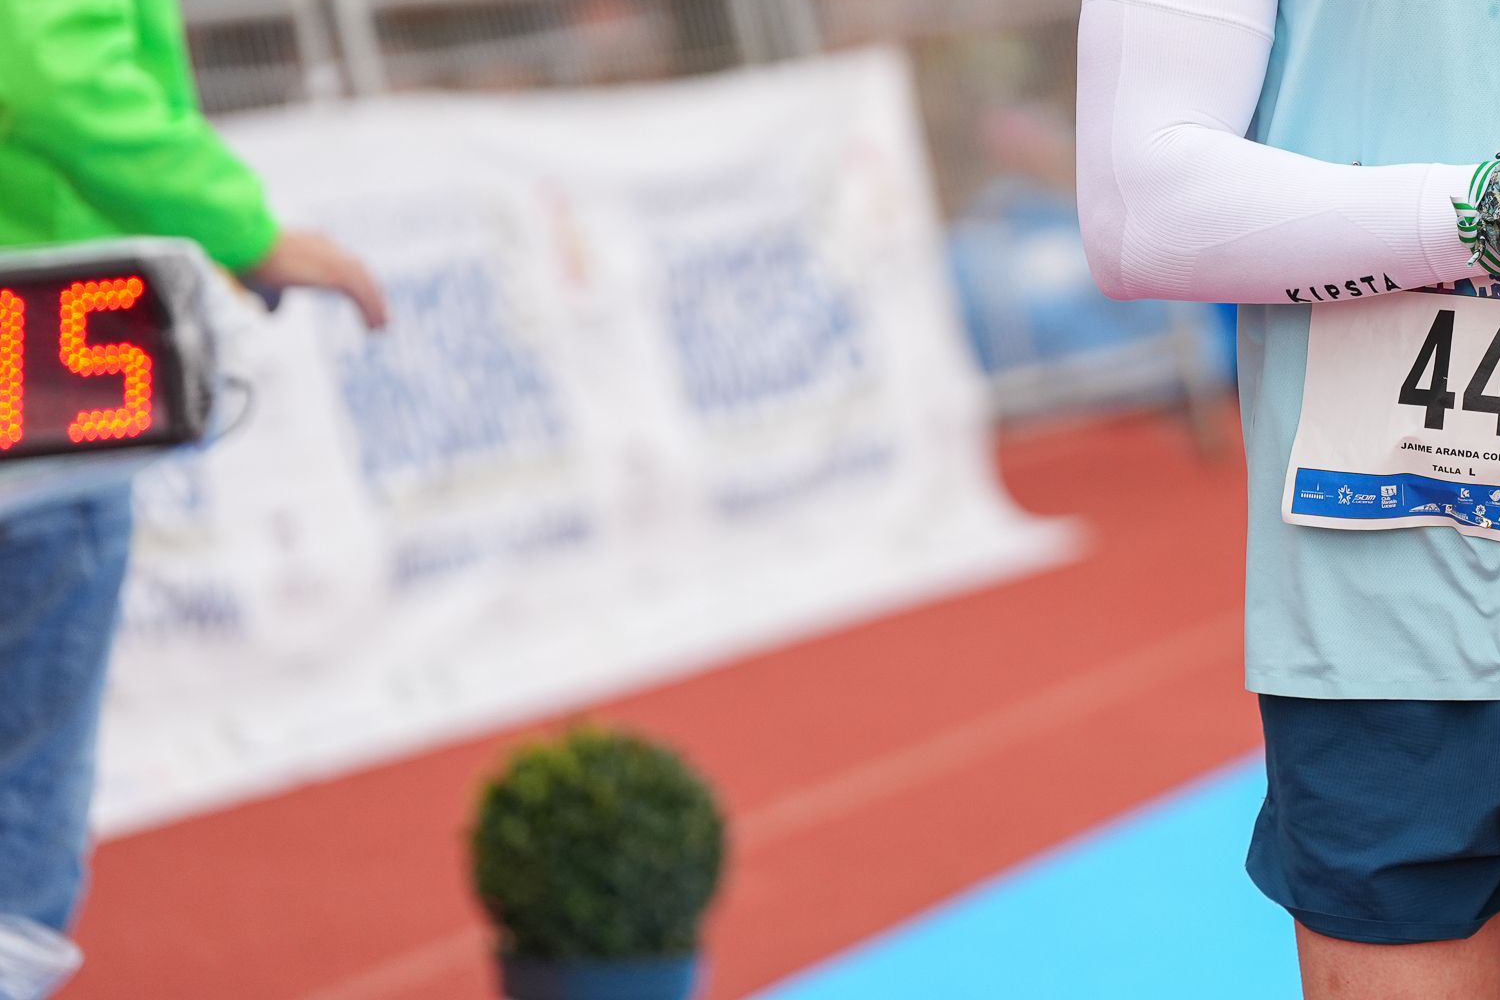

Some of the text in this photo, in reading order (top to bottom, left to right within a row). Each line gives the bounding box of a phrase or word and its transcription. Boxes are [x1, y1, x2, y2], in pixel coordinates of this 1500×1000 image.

[1286, 272, 1402, 302] KIPSTA
[1401, 442, 1433, 454] JAIME
[1435, 447, 1480, 459] ARANDA
[1432, 464, 1476, 477] TALLA L
